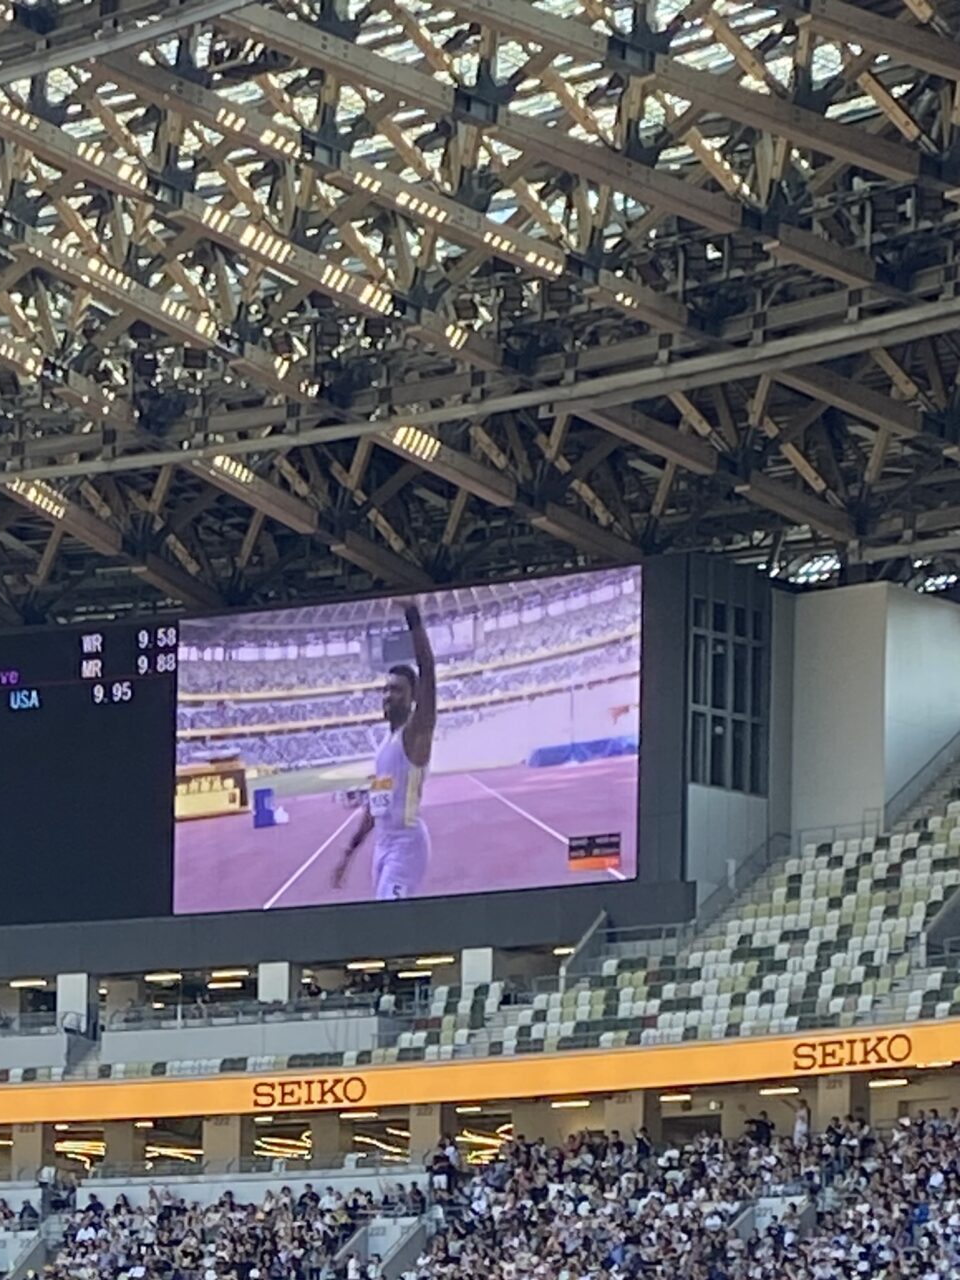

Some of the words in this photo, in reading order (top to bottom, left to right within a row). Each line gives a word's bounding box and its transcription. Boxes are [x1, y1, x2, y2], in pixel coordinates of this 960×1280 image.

[82, 633, 103, 653] WR
[138, 628, 177, 649] 9.58
[81, 659, 102, 679] MR
[10, 690, 40, 710] USA
[93, 682, 132, 704] 9.95
[793, 1033, 912, 1071] SEIKO
[253, 1076, 367, 1108] SEIKO
